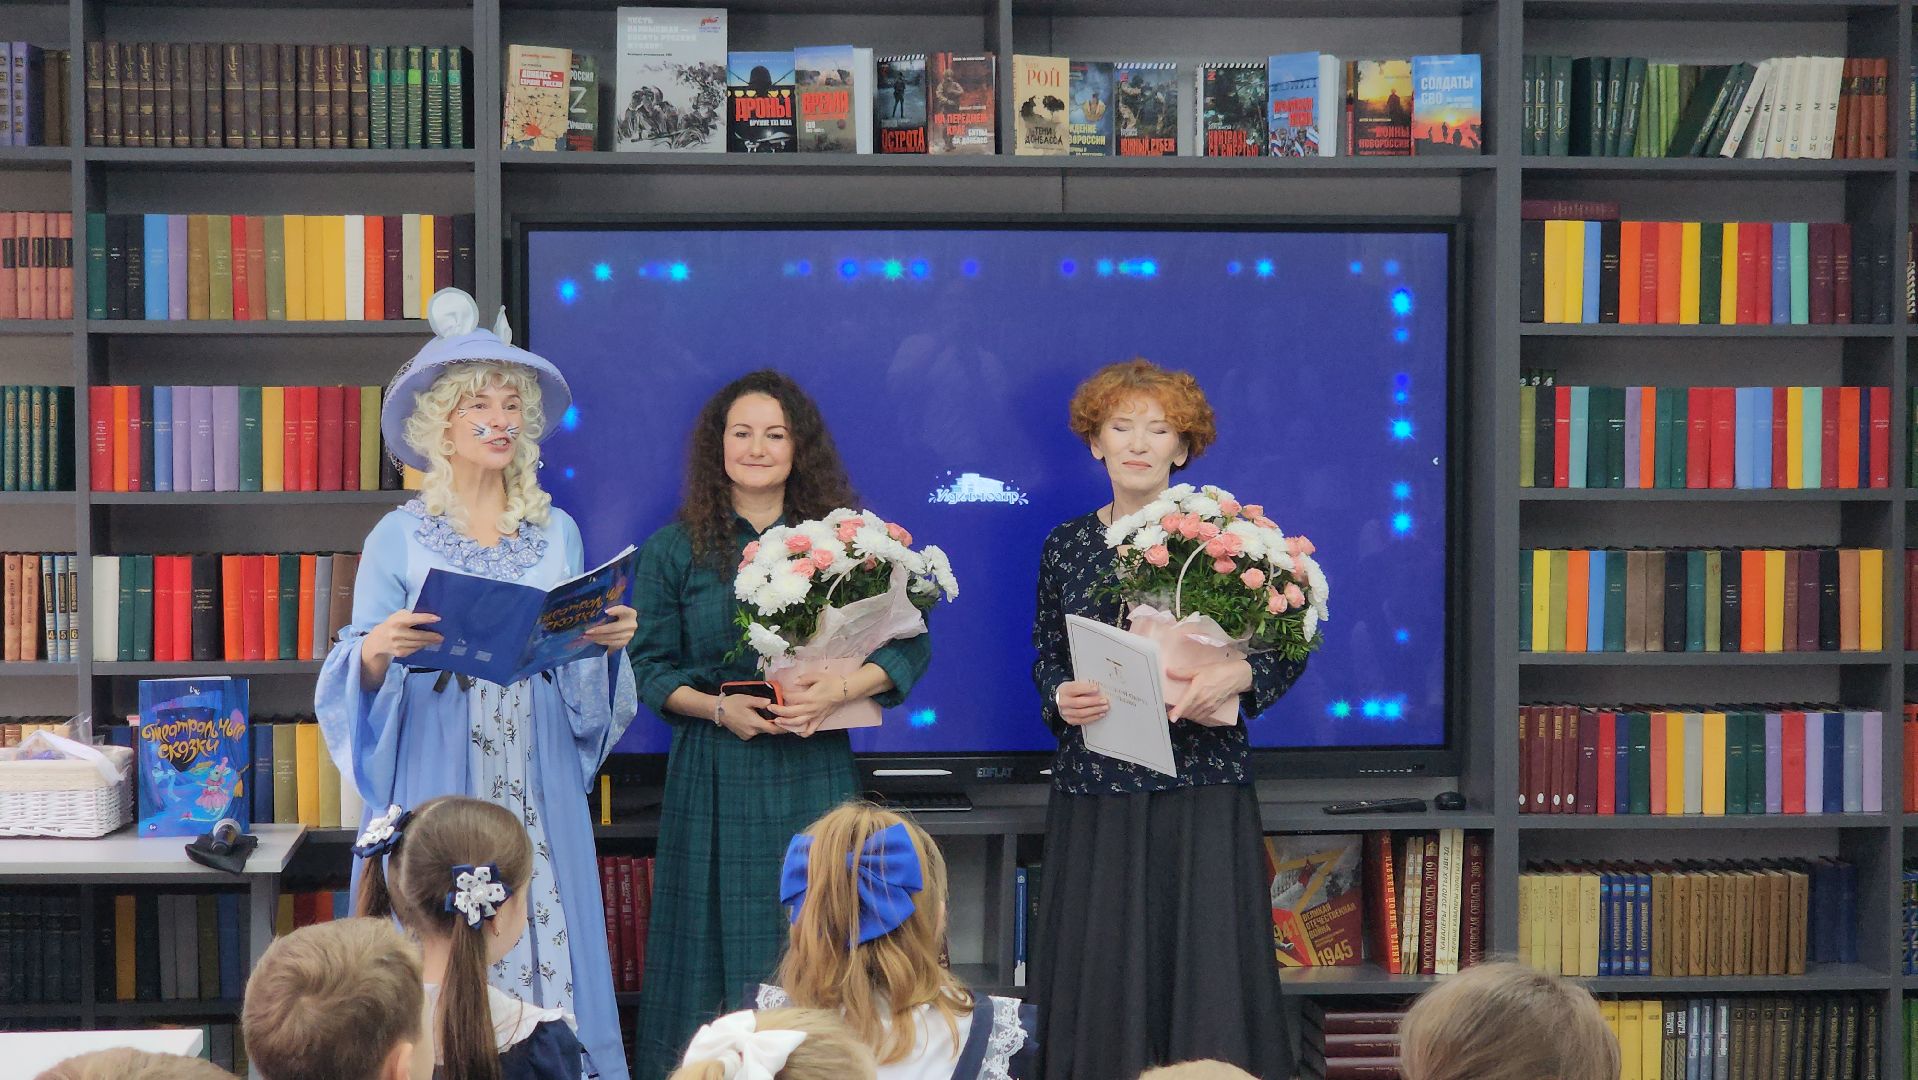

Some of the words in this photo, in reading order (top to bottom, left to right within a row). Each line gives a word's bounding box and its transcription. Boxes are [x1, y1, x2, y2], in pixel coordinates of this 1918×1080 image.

[570, 71, 594, 82] РОССИЯ
[1027, 67, 1060, 87] РОЙ
[1421, 76, 1473, 91] СОЛДАТЫ
[735, 94, 792, 121] ДРОНЫ
[1421, 92, 1442, 105] СВО
[882, 127, 926, 153] ОСТРОТА
[1025, 135, 1063, 145] ДОНБАССА
[1034, 127, 1052, 135] ТЕНИ
[1208, 130, 1247, 144] КОНТРАКТ
[1220, 144, 1259, 157] СМЕРТЬЮ
[1532, 376, 1540, 386] 3
[48, 630, 55, 639] 4
[60, 630, 67, 640] 5
[71, 629, 78, 639] 6
[1425, 861, 1437, 881] 2019
[1441, 872, 1449, 909] ЗОЛОТЫХ
[1470, 882, 1481, 914] ОБЛАСТЬ
[1424, 884, 1436, 917] ОБЛАСТЬ
[1302, 902, 1332, 921] ВЕЛИКАЯ
[1305, 902, 1358, 931] ОТЕЧЕСТВЕННАЯ
[1309, 922, 1332, 940] ВОЙНА
[1423, 919, 1434, 969] МОСКОВСКАЯ
[1469, 917, 1480, 967] МОСКОВСКАЯ
[1318, 939, 1354, 966] 1945
